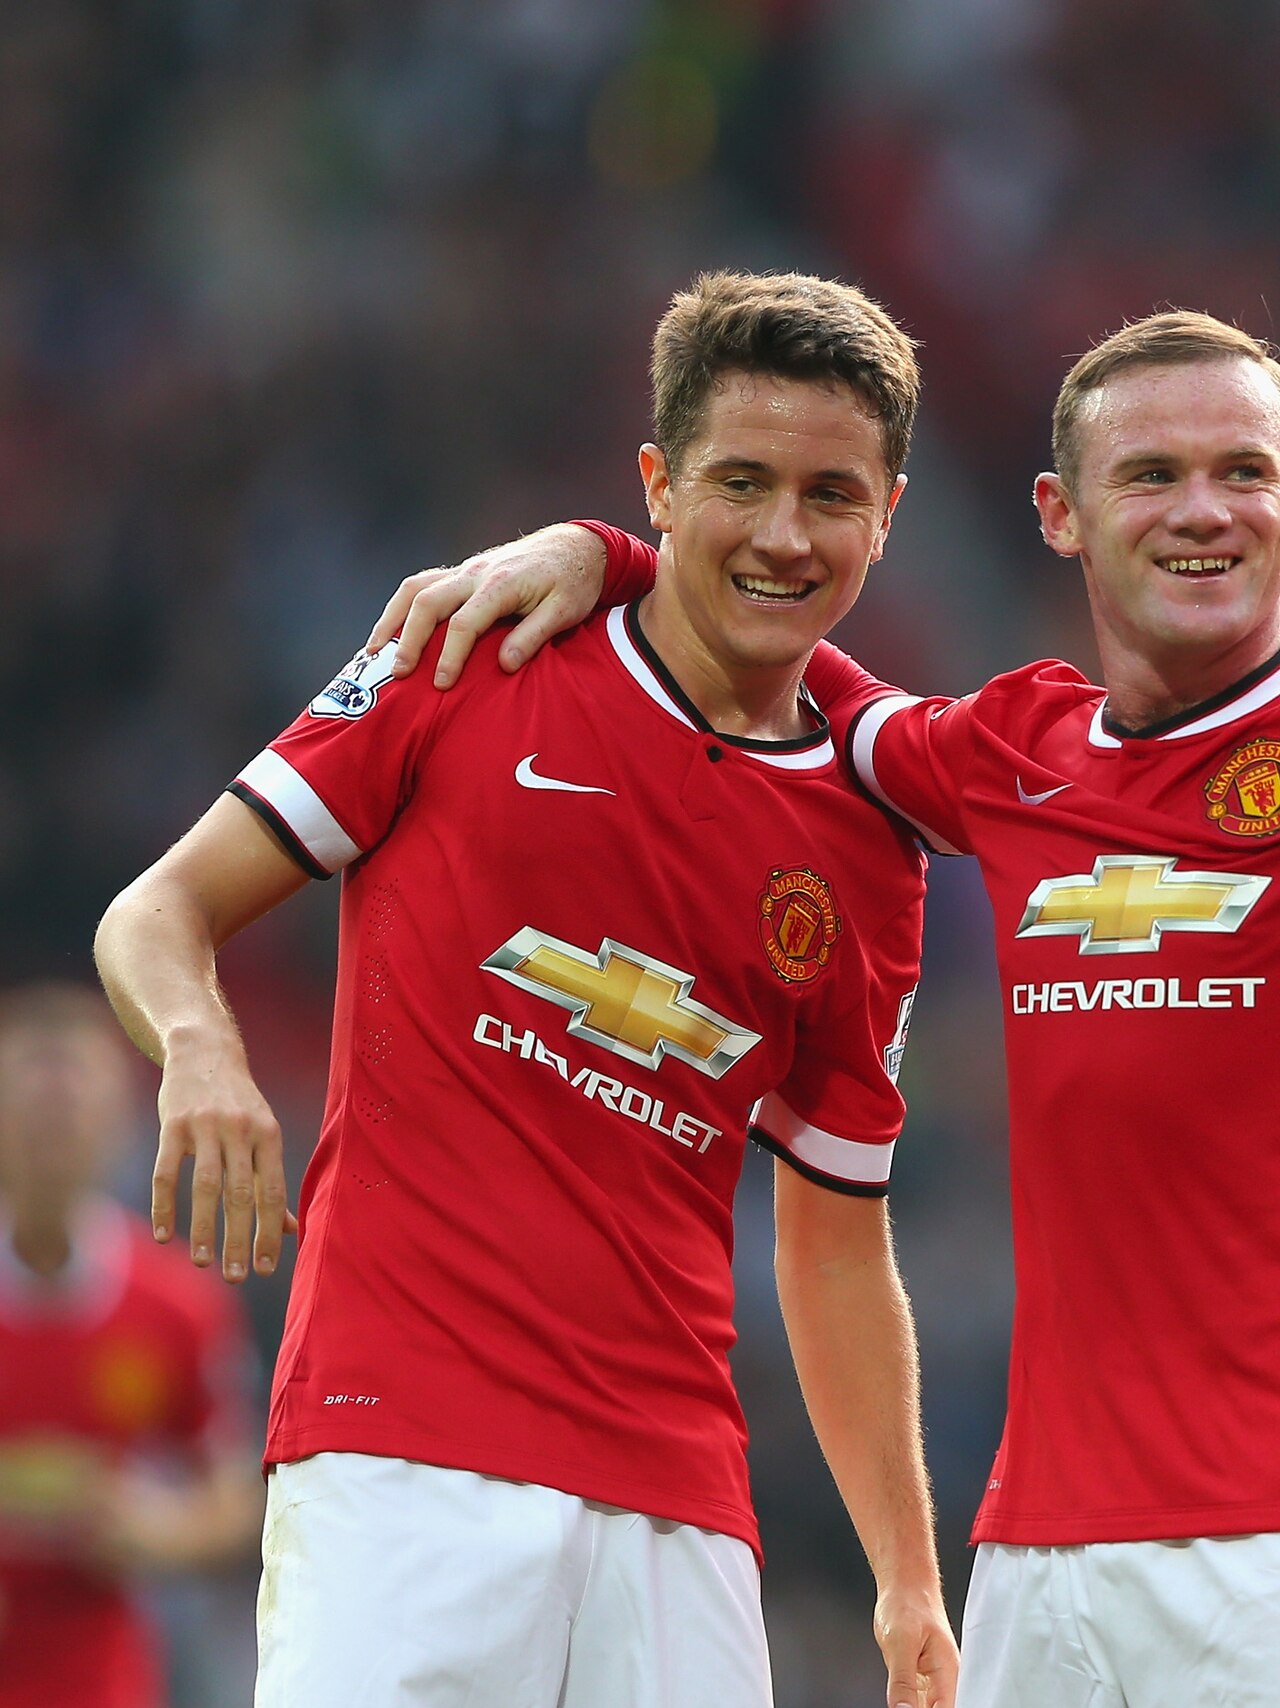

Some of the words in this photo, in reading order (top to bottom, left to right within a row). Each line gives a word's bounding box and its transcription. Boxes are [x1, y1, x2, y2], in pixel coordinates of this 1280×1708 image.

[775, 876, 834, 935] MANCHESTER
[766, 938, 806, 977] UNITED
[1012, 977, 1266, 1015] CHEVROLET
[323, 1394, 380, 1406] DRI-FIT
